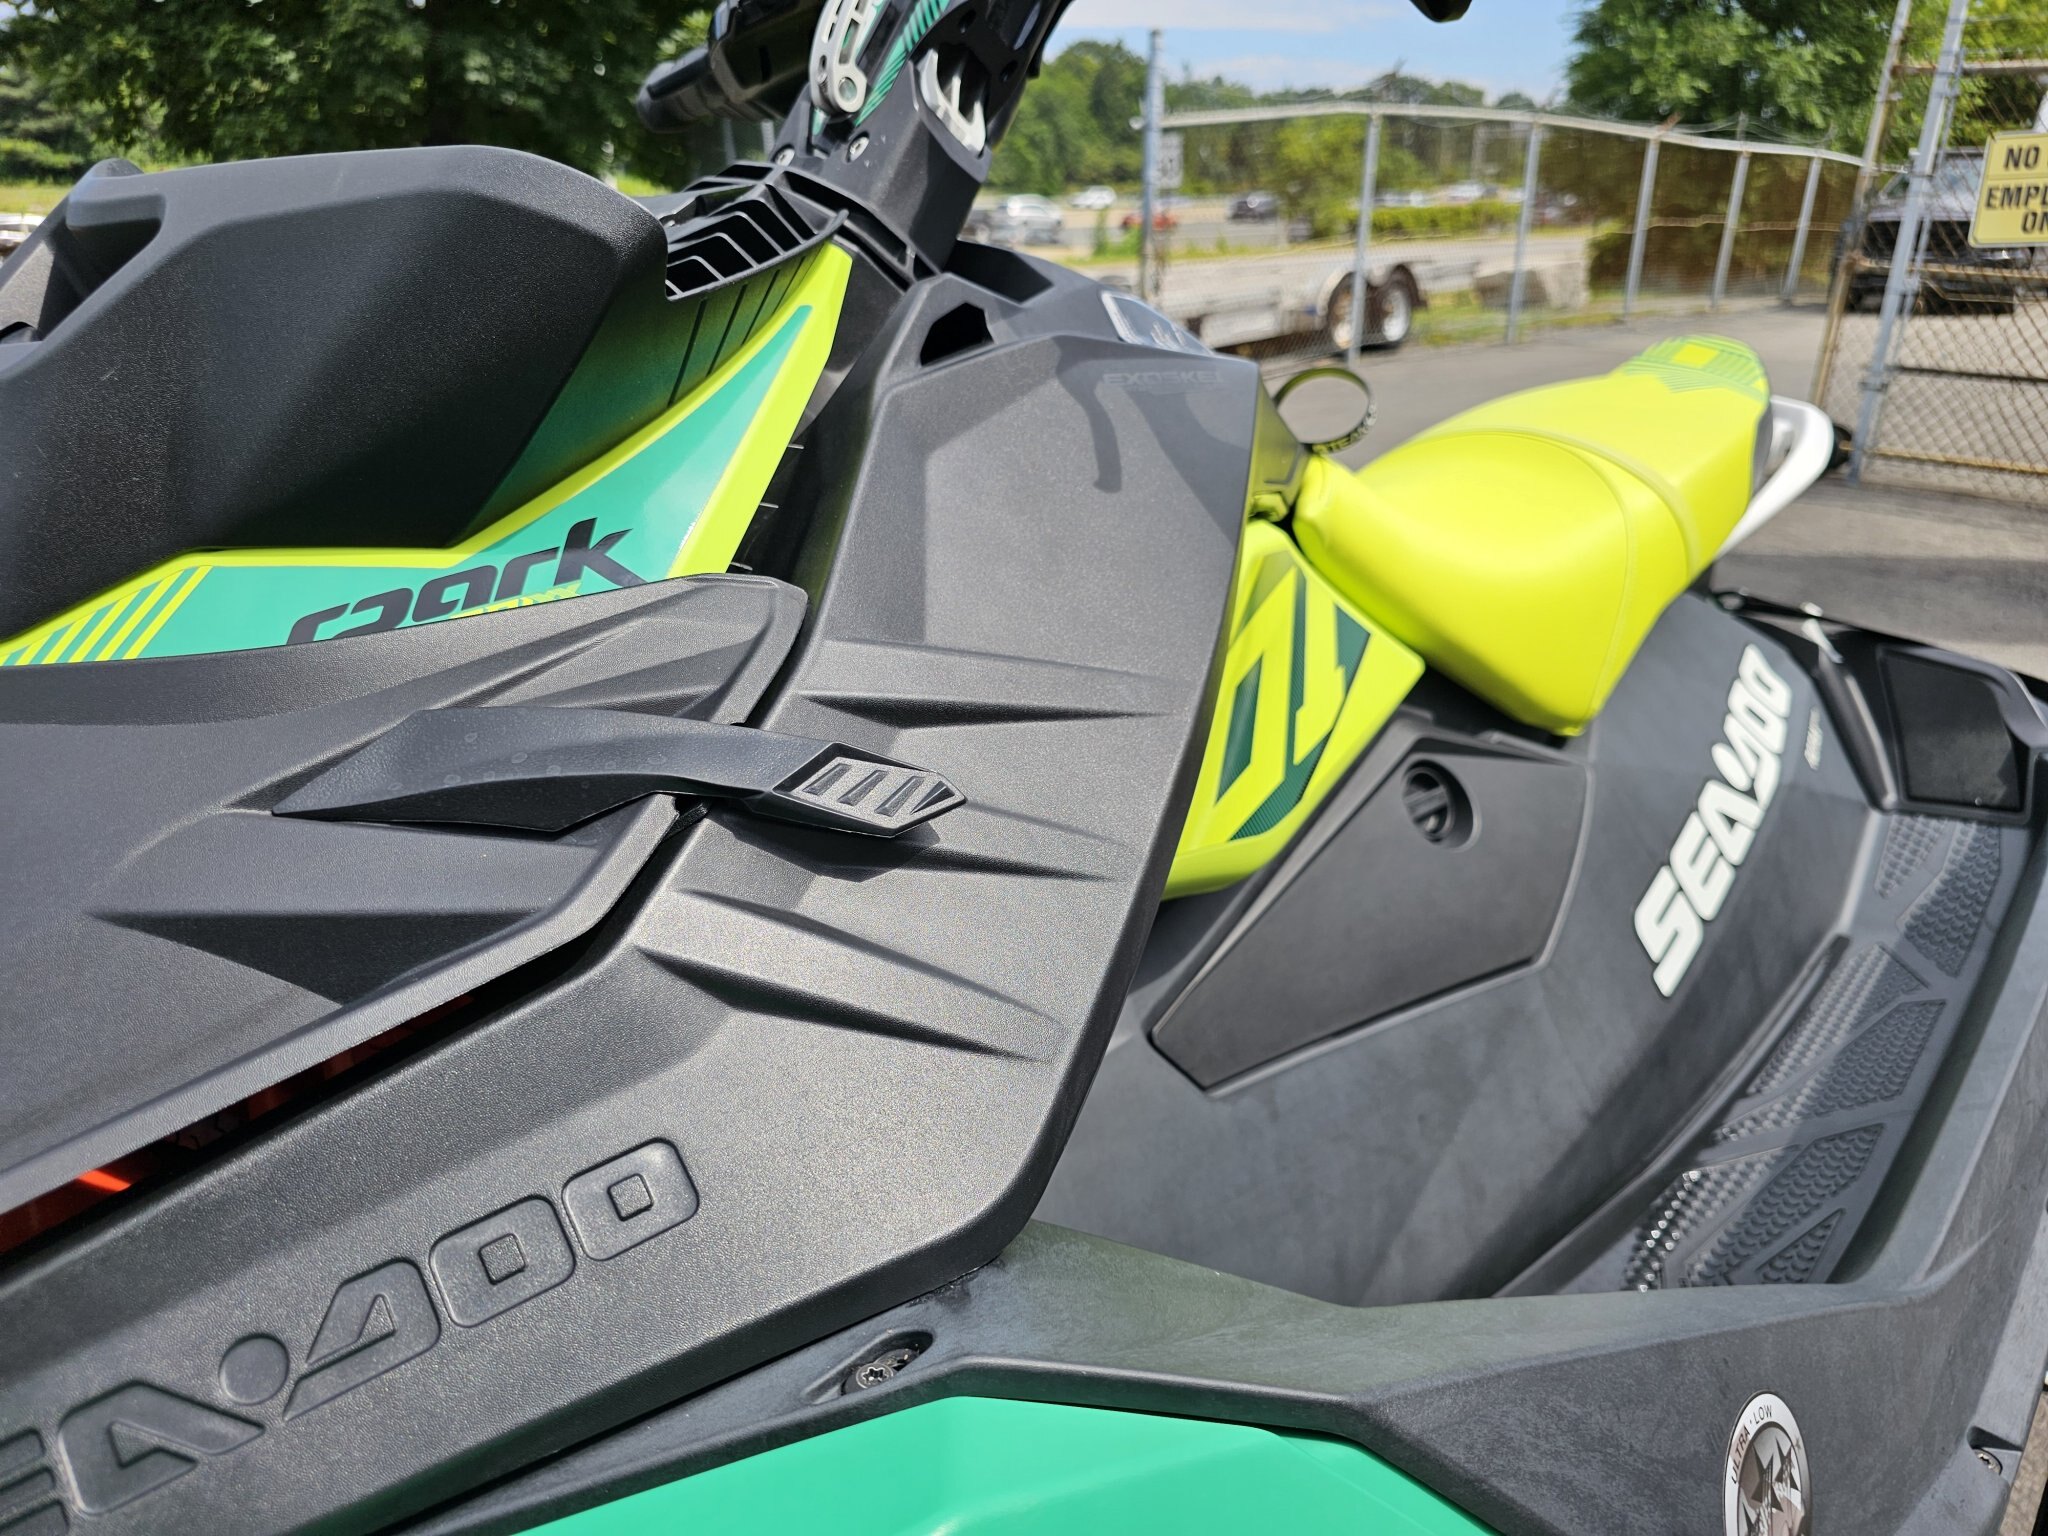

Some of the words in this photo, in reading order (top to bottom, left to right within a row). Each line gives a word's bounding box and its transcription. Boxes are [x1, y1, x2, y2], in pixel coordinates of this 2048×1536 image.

[2004, 145, 2040, 170] NO
[1731, 1425, 1751, 1485] ULTRA
[1752, 1405, 1773, 1425] LOW
